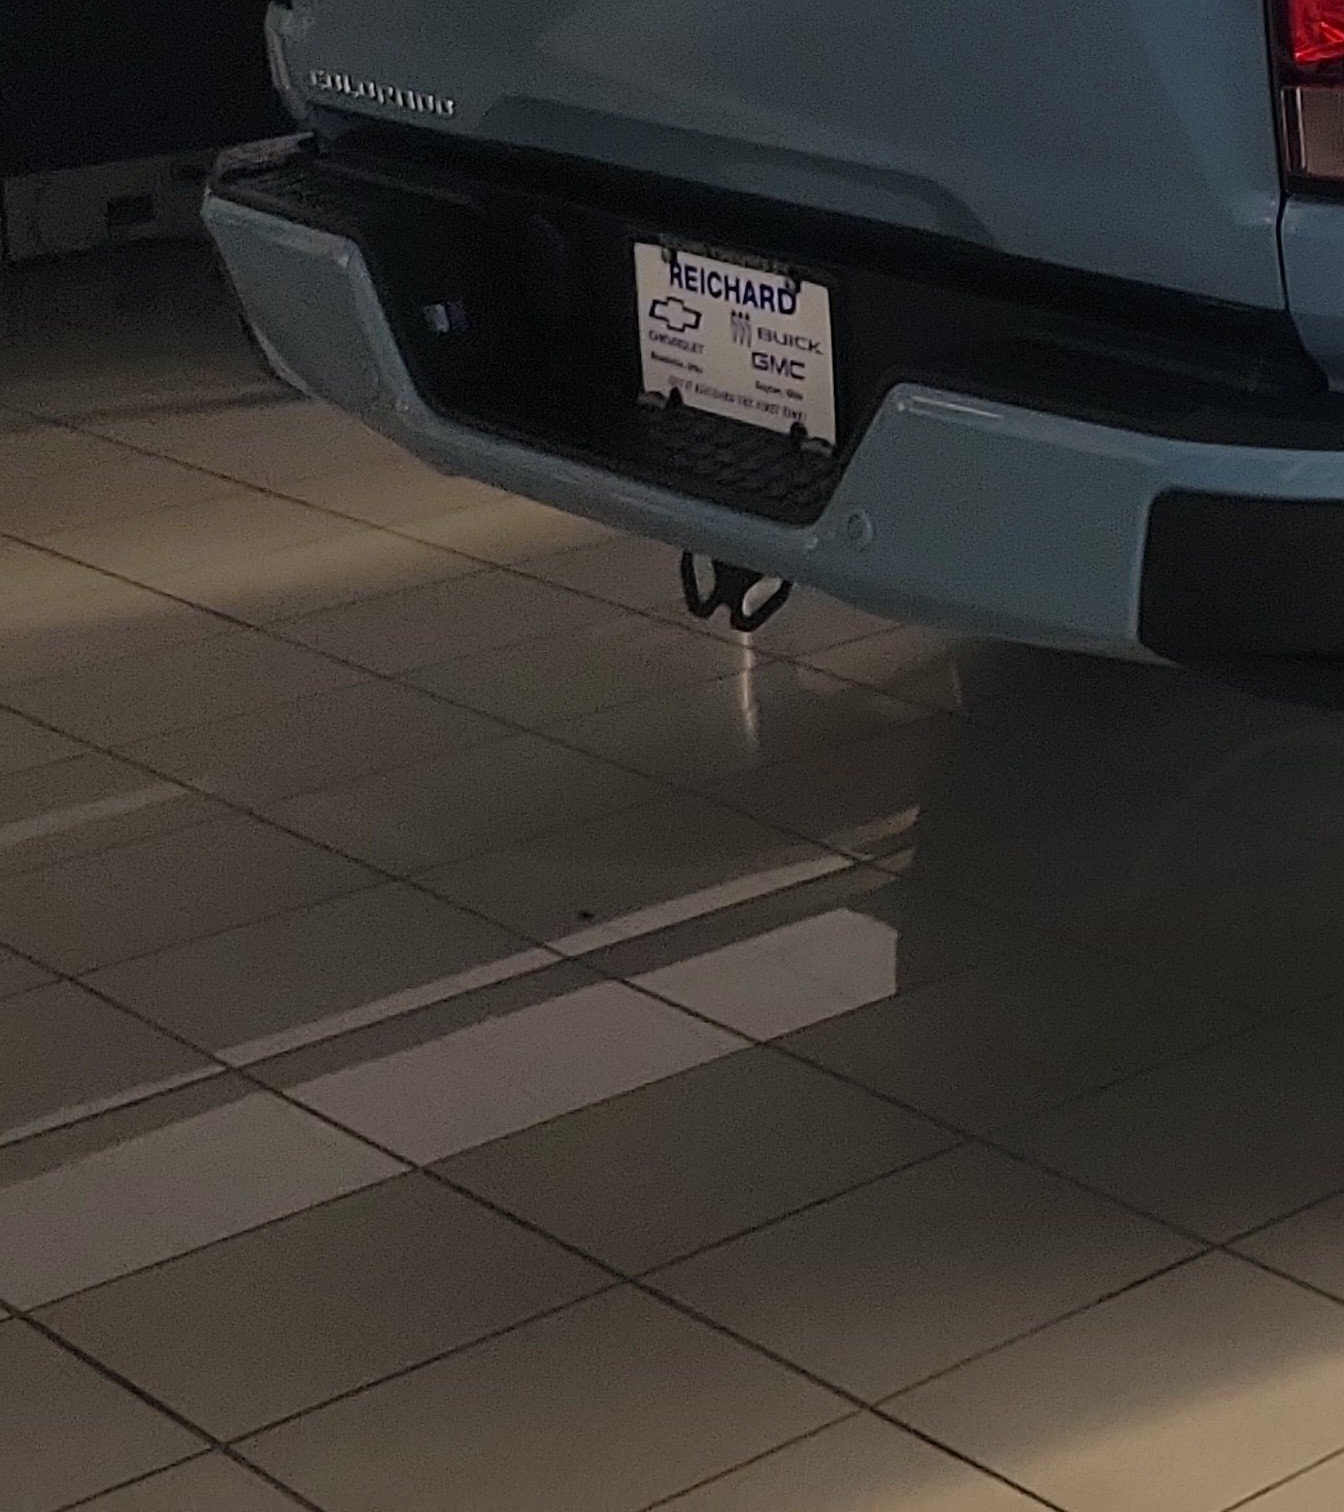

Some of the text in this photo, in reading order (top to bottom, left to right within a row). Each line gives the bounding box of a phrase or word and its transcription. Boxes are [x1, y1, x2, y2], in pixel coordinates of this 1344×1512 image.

[669, 261, 798, 316] REICHARD
[757, 327, 824, 355] BUICK
[751, 351, 806, 381] GMC
